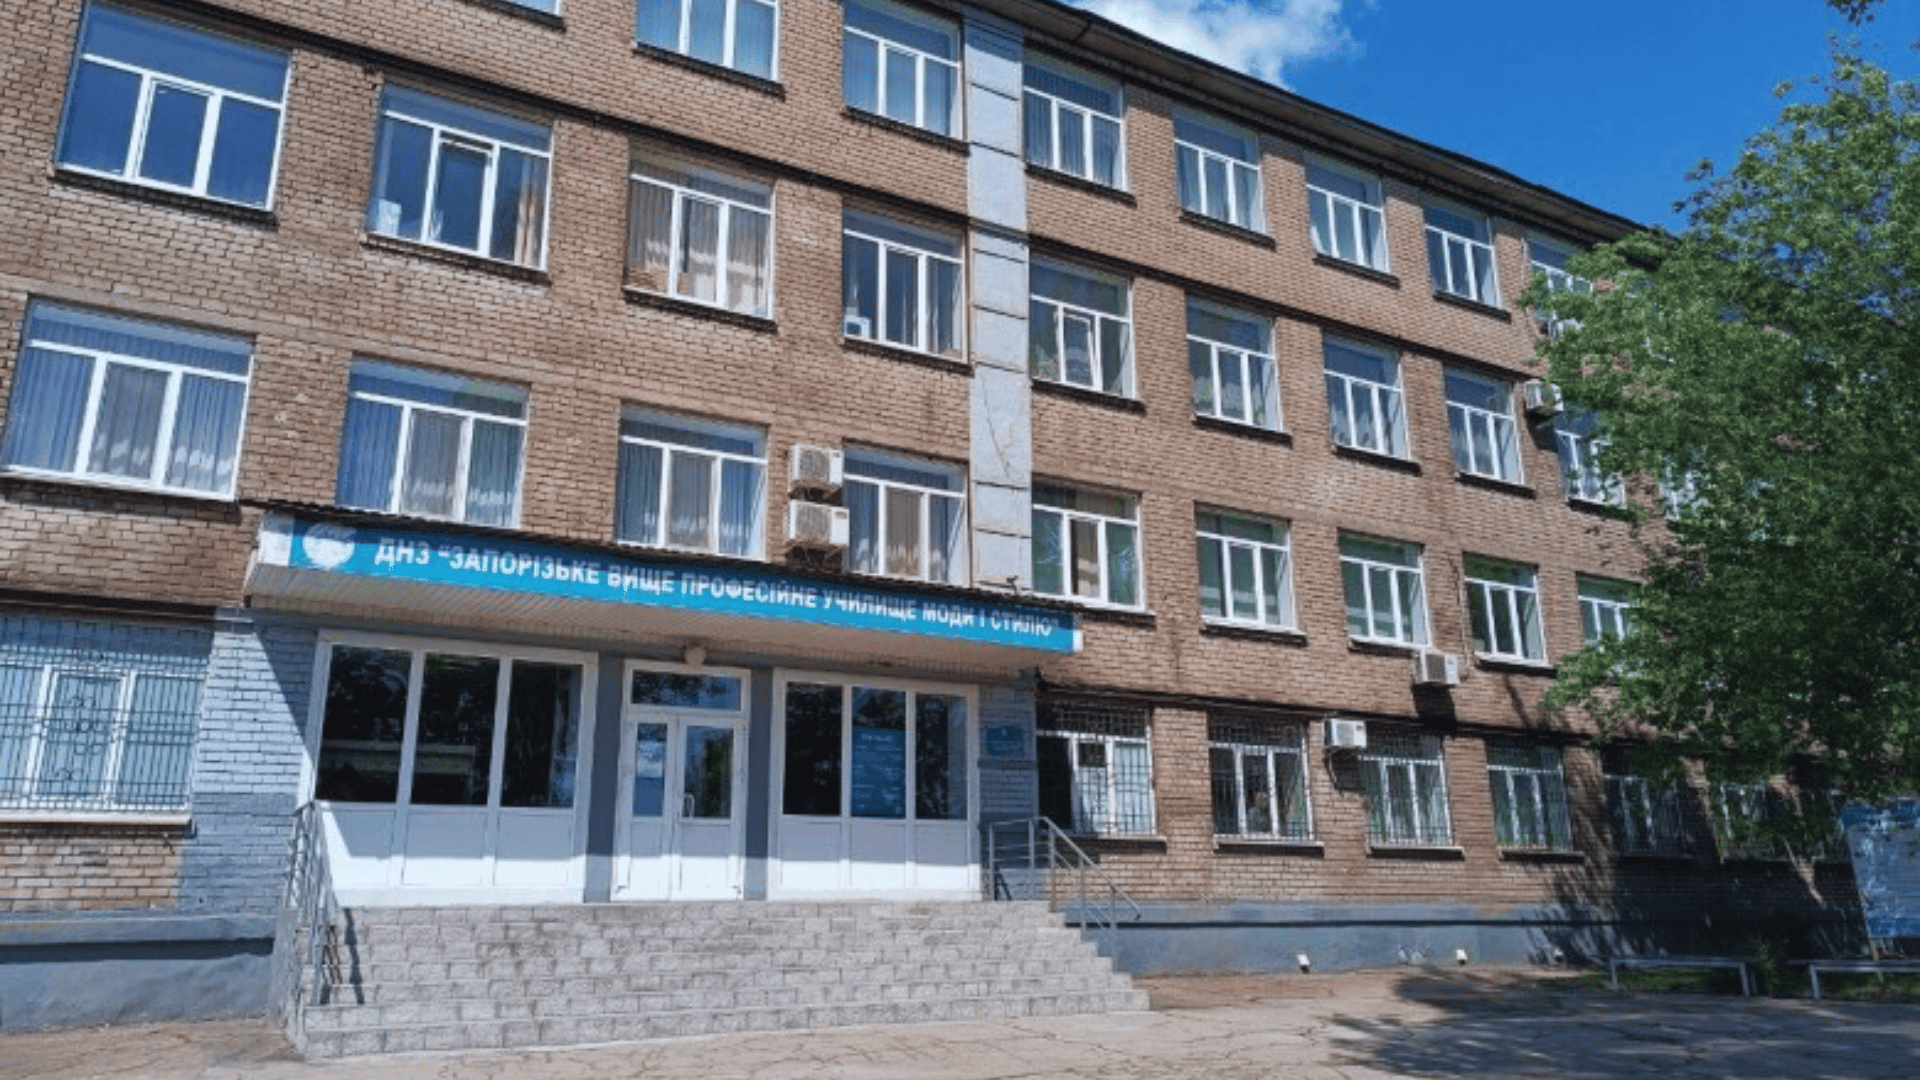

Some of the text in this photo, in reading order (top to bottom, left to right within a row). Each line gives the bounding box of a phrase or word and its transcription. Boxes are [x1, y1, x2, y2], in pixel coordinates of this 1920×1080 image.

[375, 538, 430, 568] ДНЗ
[606, 564, 676, 595] ВИЩЕ
[681, 573, 817, 608] ПРОФЕСІЙНЕ
[823, 589, 917, 621] УЧИЛИЩЕ
[922, 602, 975, 628] МОДИ
[979, 608, 986, 628] І
